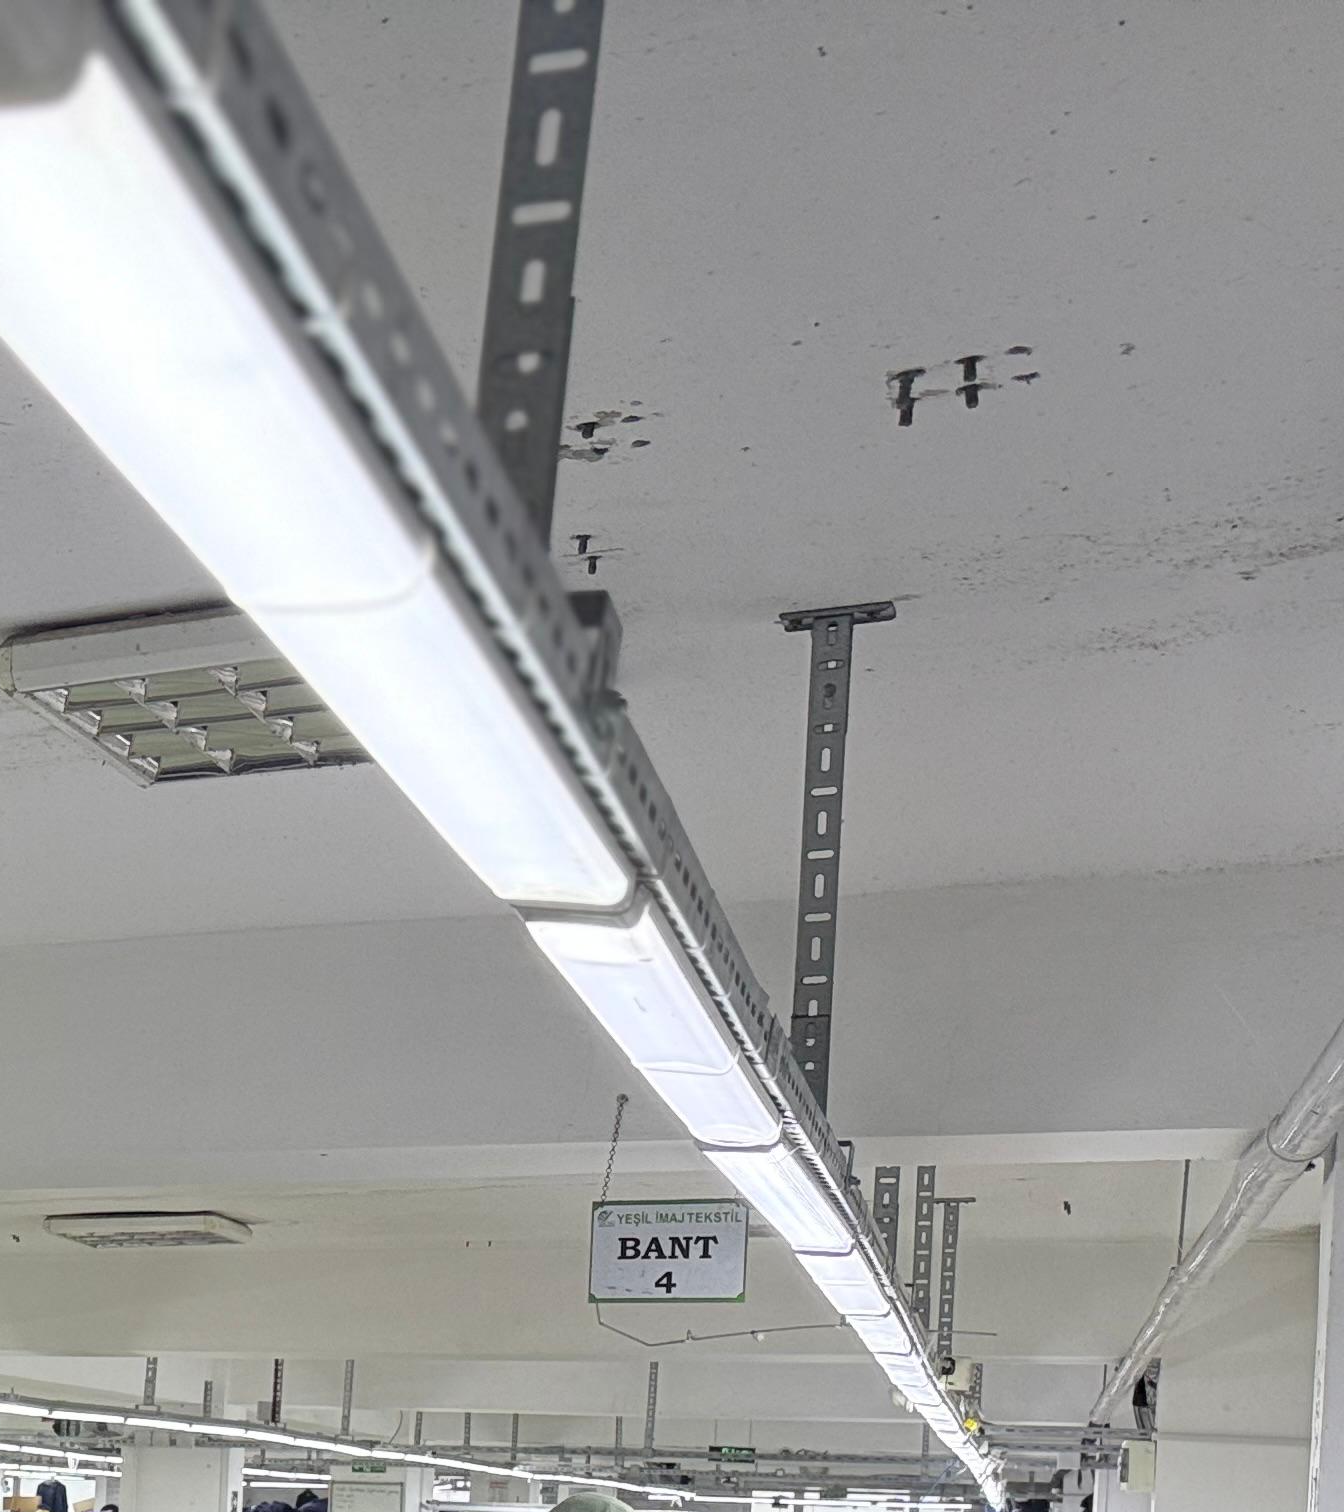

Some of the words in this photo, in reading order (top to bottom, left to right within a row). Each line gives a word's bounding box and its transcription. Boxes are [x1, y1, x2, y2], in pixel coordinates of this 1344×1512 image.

[617, 1211, 653, 1226] YEŞİL
[656, 1211, 685, 1224] İMAJ
[687, 1209, 743, 1223] TEKSTİL
[617, 1235, 719, 1260] BANT
[654, 1271, 677, 1294] 4
